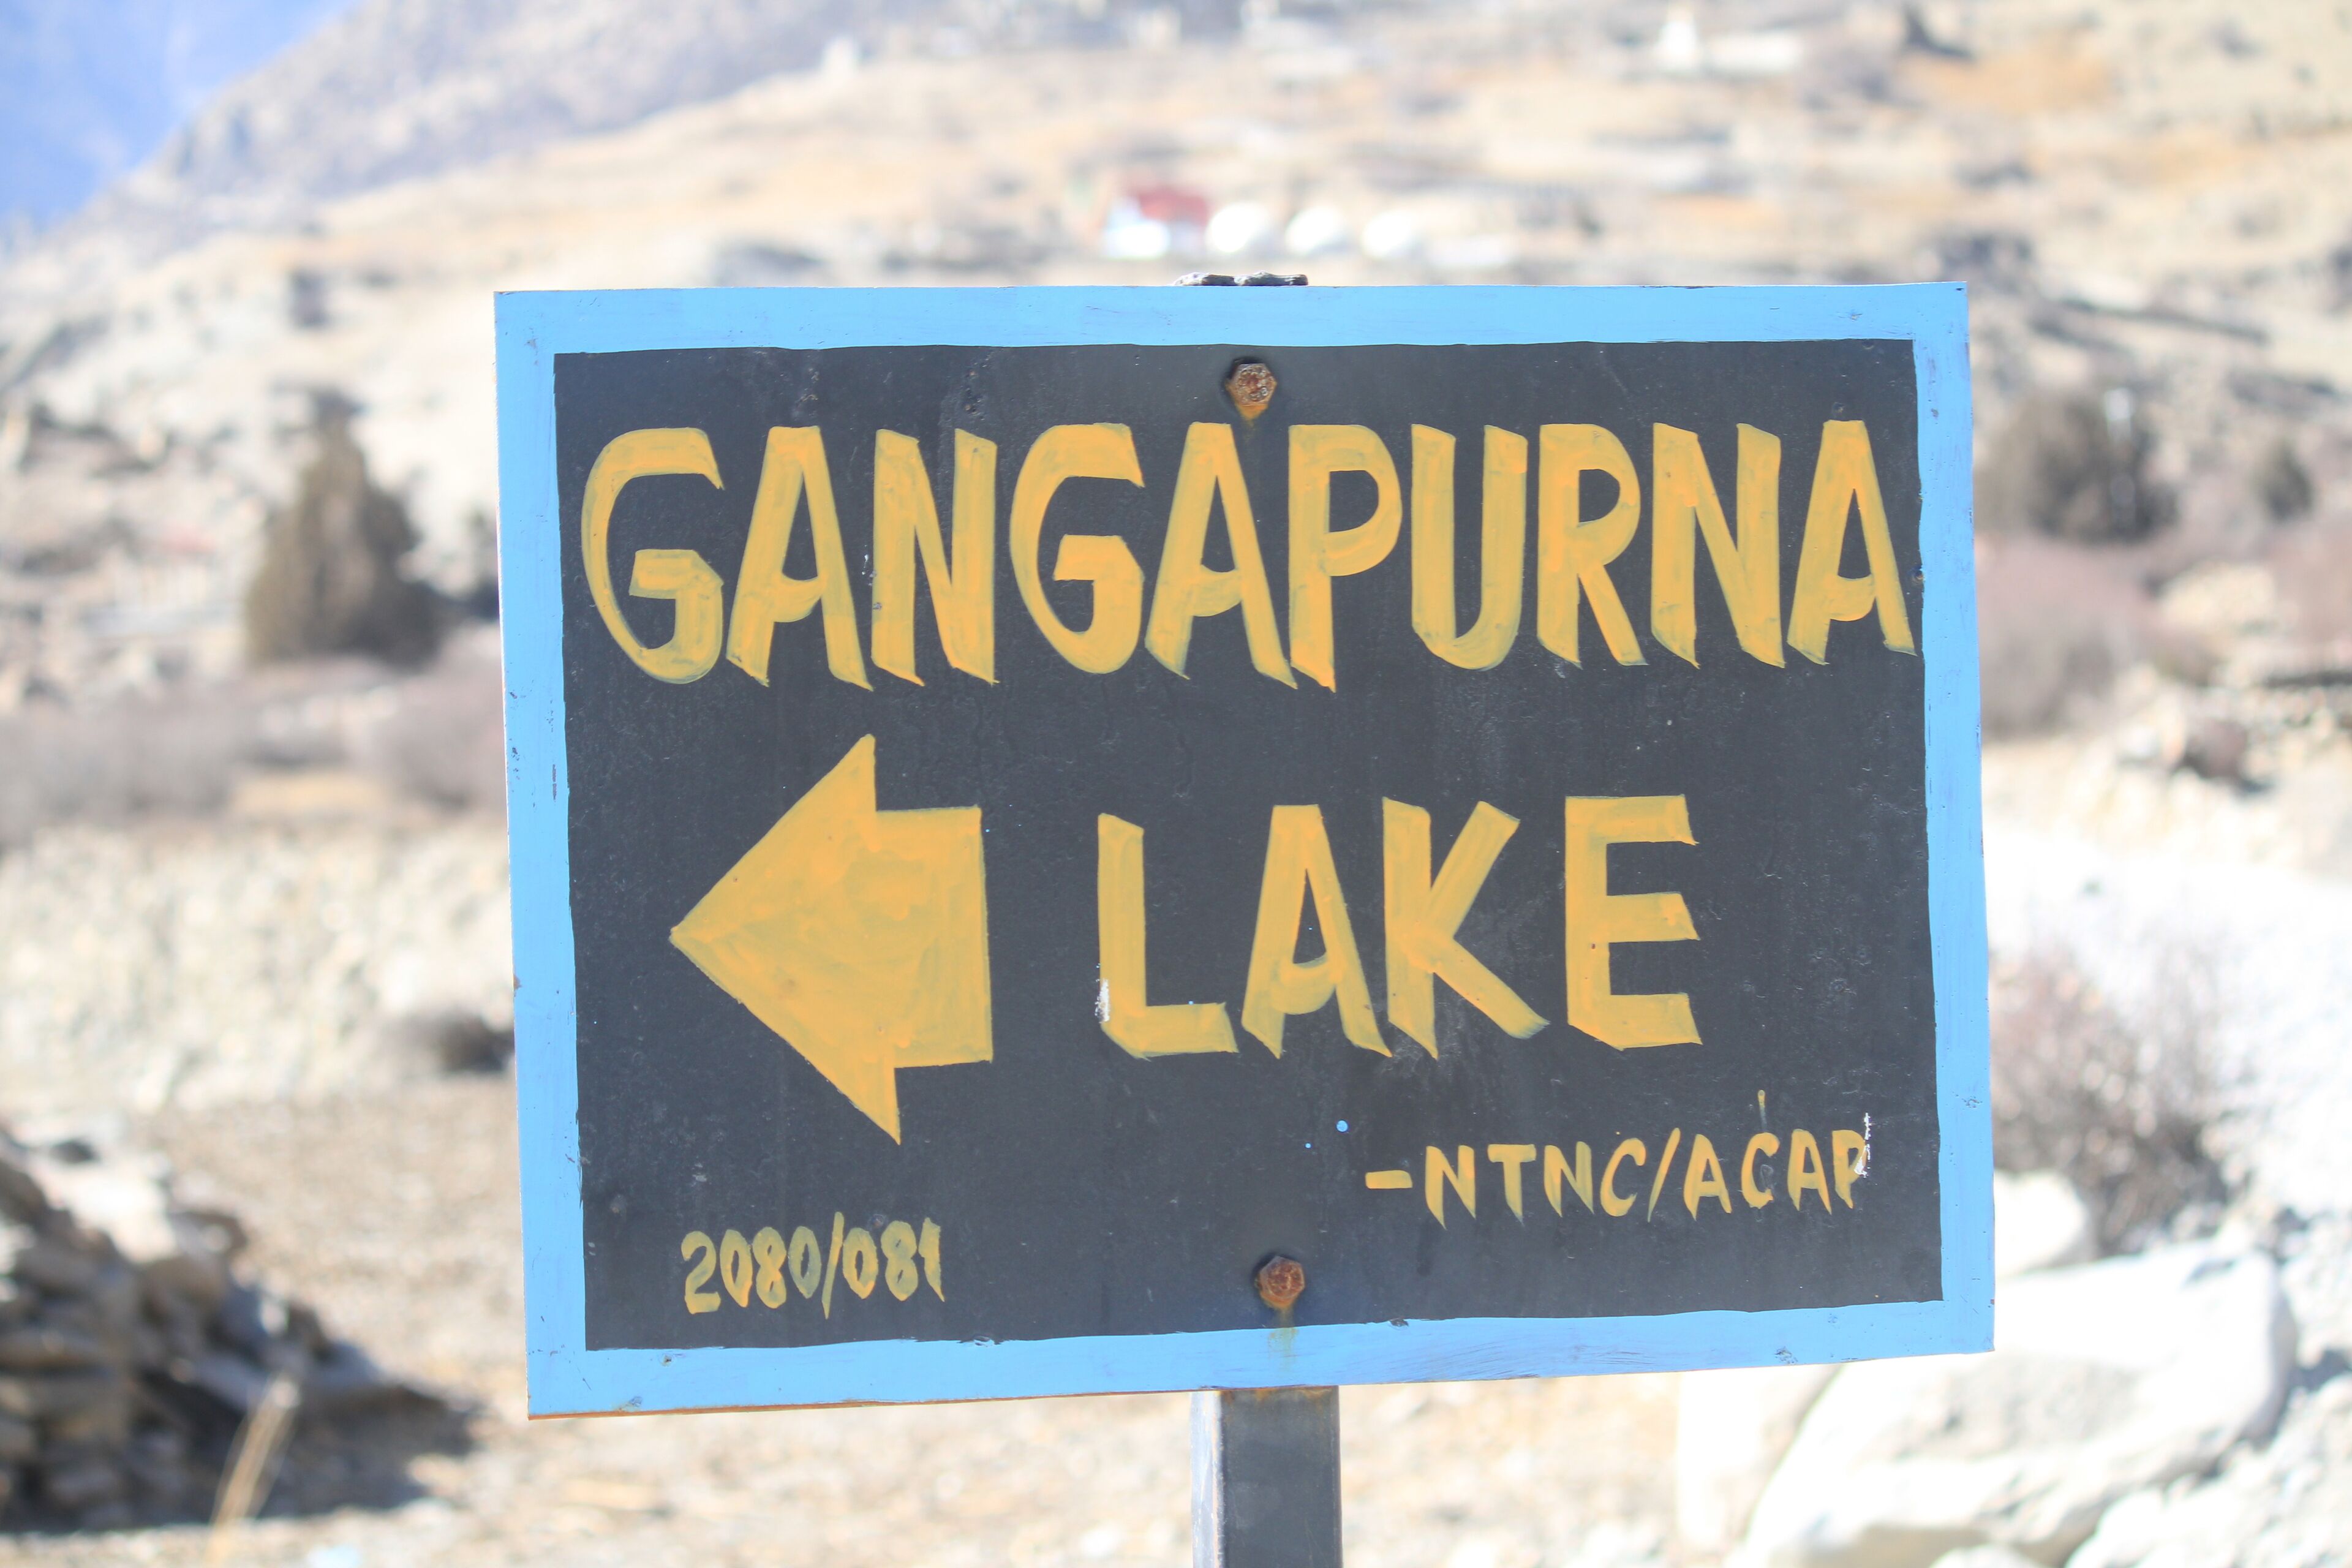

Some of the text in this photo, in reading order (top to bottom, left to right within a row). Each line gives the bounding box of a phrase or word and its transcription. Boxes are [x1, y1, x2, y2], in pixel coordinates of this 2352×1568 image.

[581, 420, 1917, 691] GANGAPURNA
[1097, 796, 1702, 1060] LAKE
[681, 1212, 945, 1319] 2080/081
